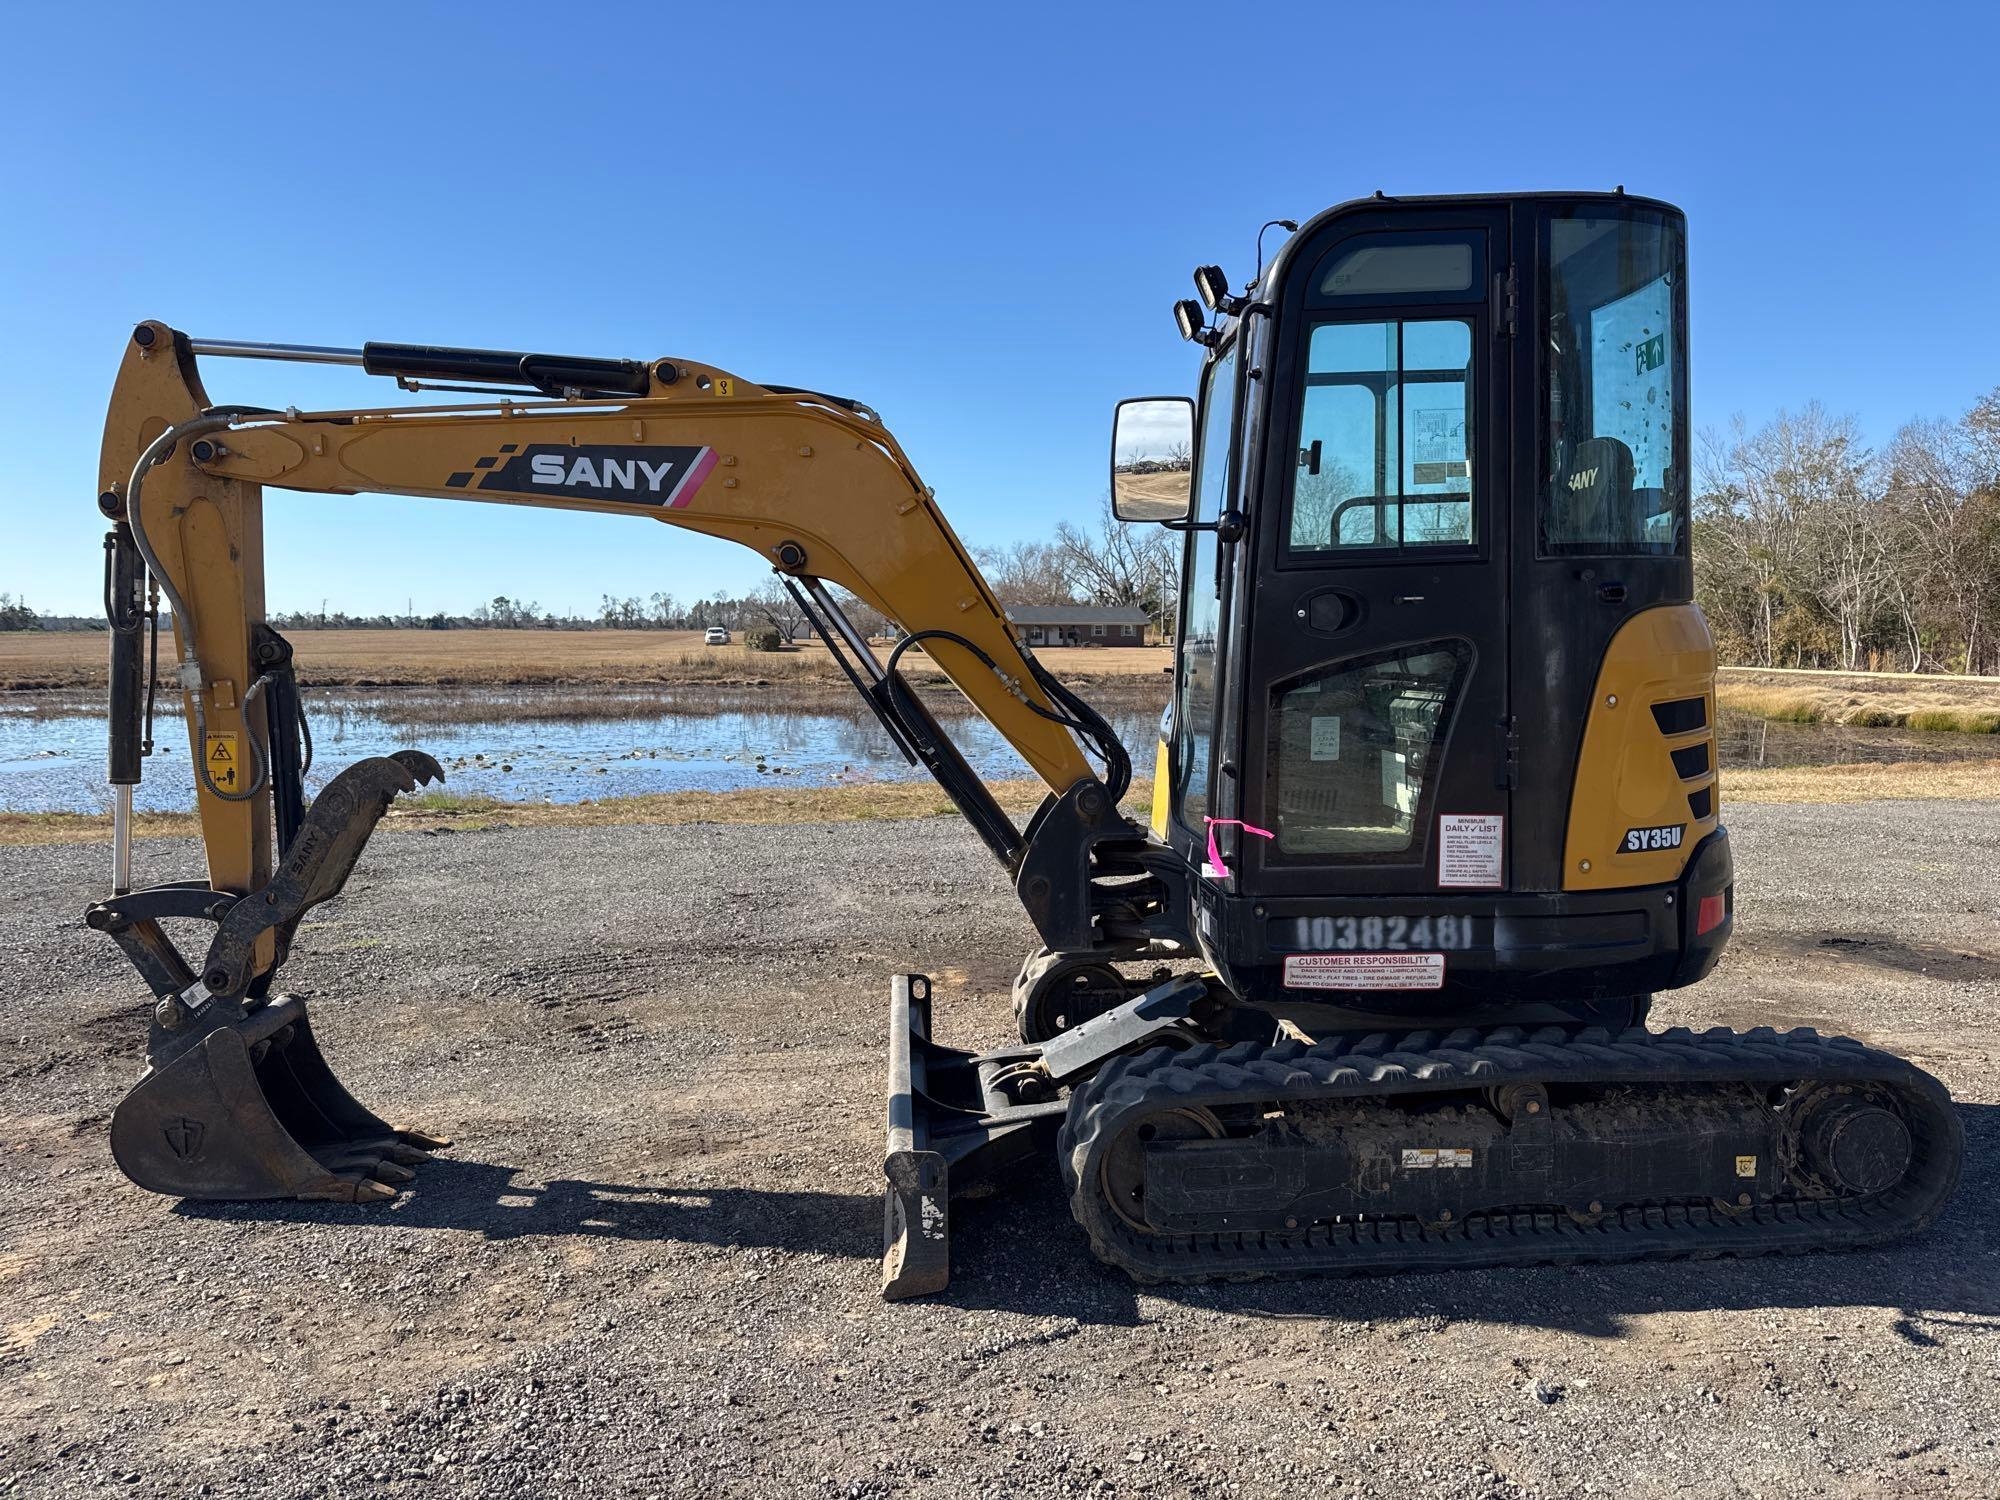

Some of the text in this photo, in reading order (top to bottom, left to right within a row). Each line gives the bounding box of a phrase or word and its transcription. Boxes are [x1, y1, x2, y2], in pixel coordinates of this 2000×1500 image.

[531, 454, 674, 491] SANY
[1445, 824, 1470, 832] DAILY
[1627, 826, 1680, 850] SY35U
[1297, 914, 1472, 950] 10382481
[1298, 956, 1430, 966] CUSTOMER RESPONSIBILITY
